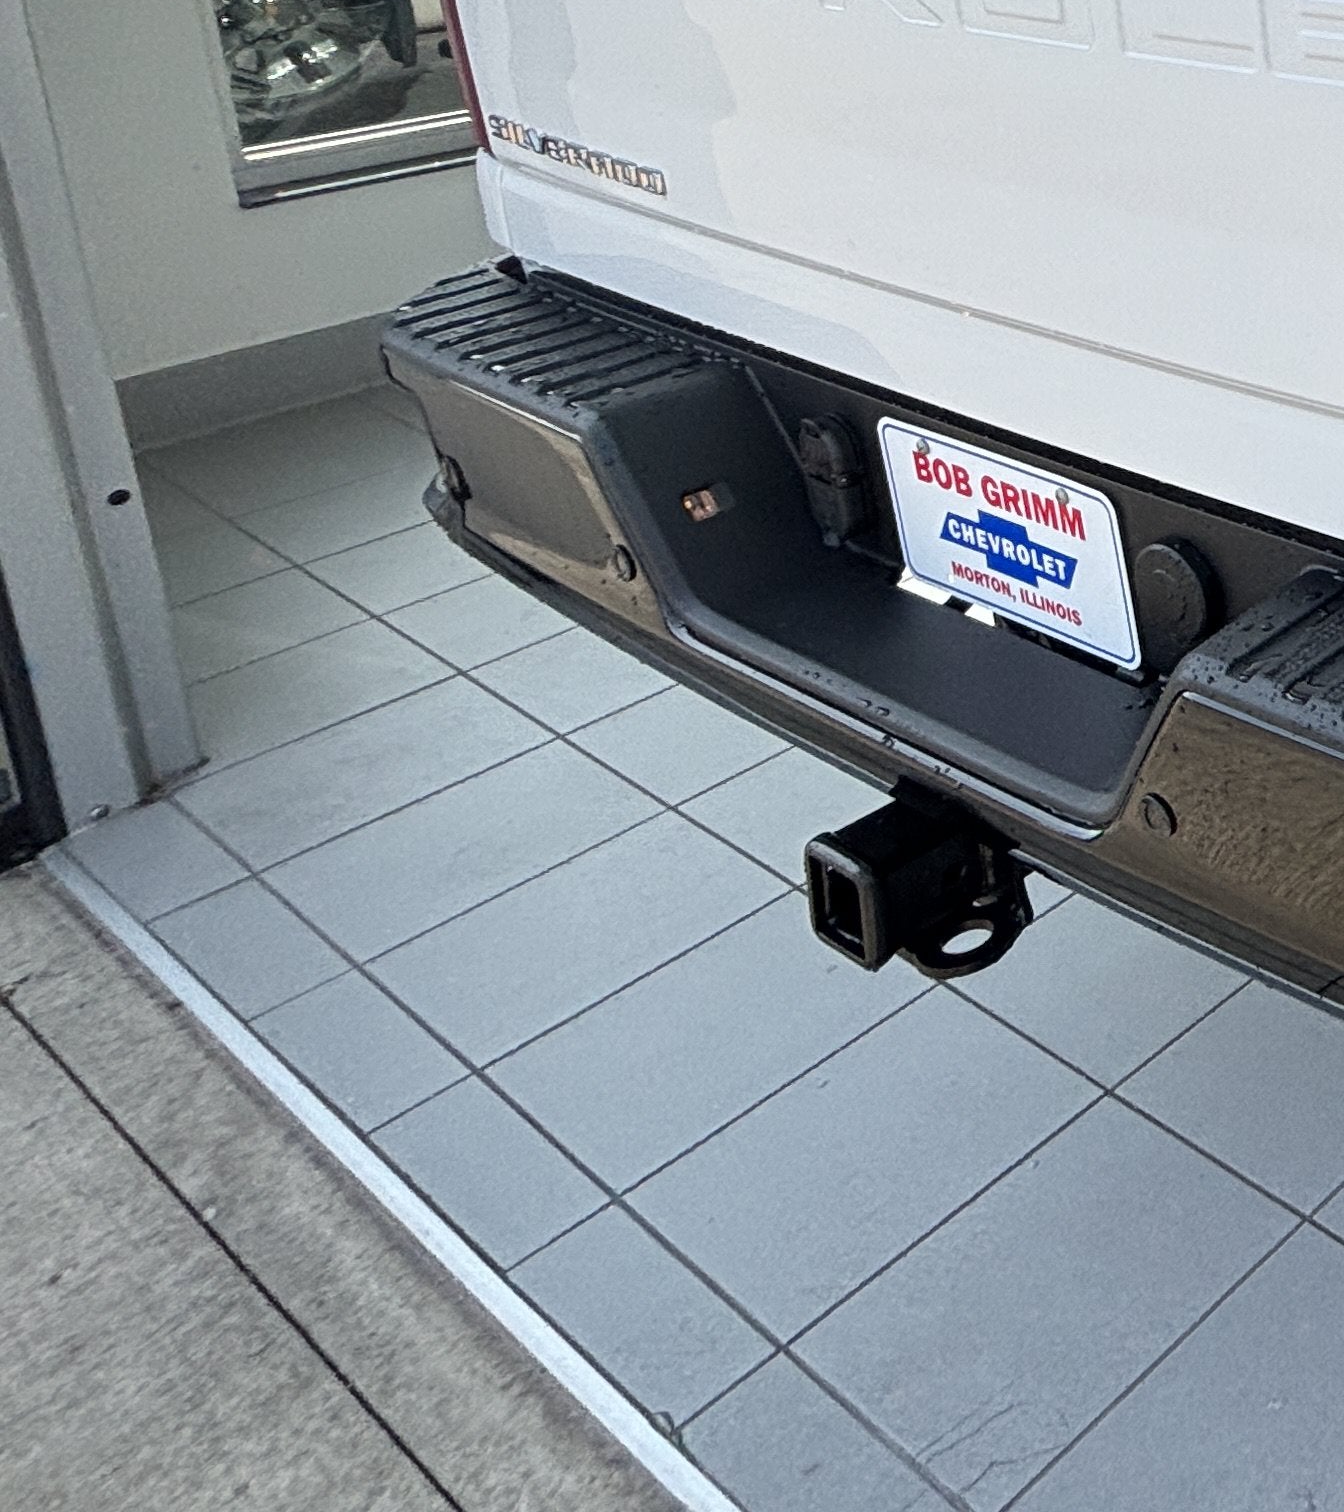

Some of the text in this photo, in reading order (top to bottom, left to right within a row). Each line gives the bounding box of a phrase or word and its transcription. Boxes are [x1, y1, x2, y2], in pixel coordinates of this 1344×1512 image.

[488, 114, 668, 197] SILVERADO
[912, 450, 1087, 541] BOB GRIMM
[947, 518, 1067, 581] CHEVROLET
[951, 561, 1083, 626] MORTON, ILLINOIS
